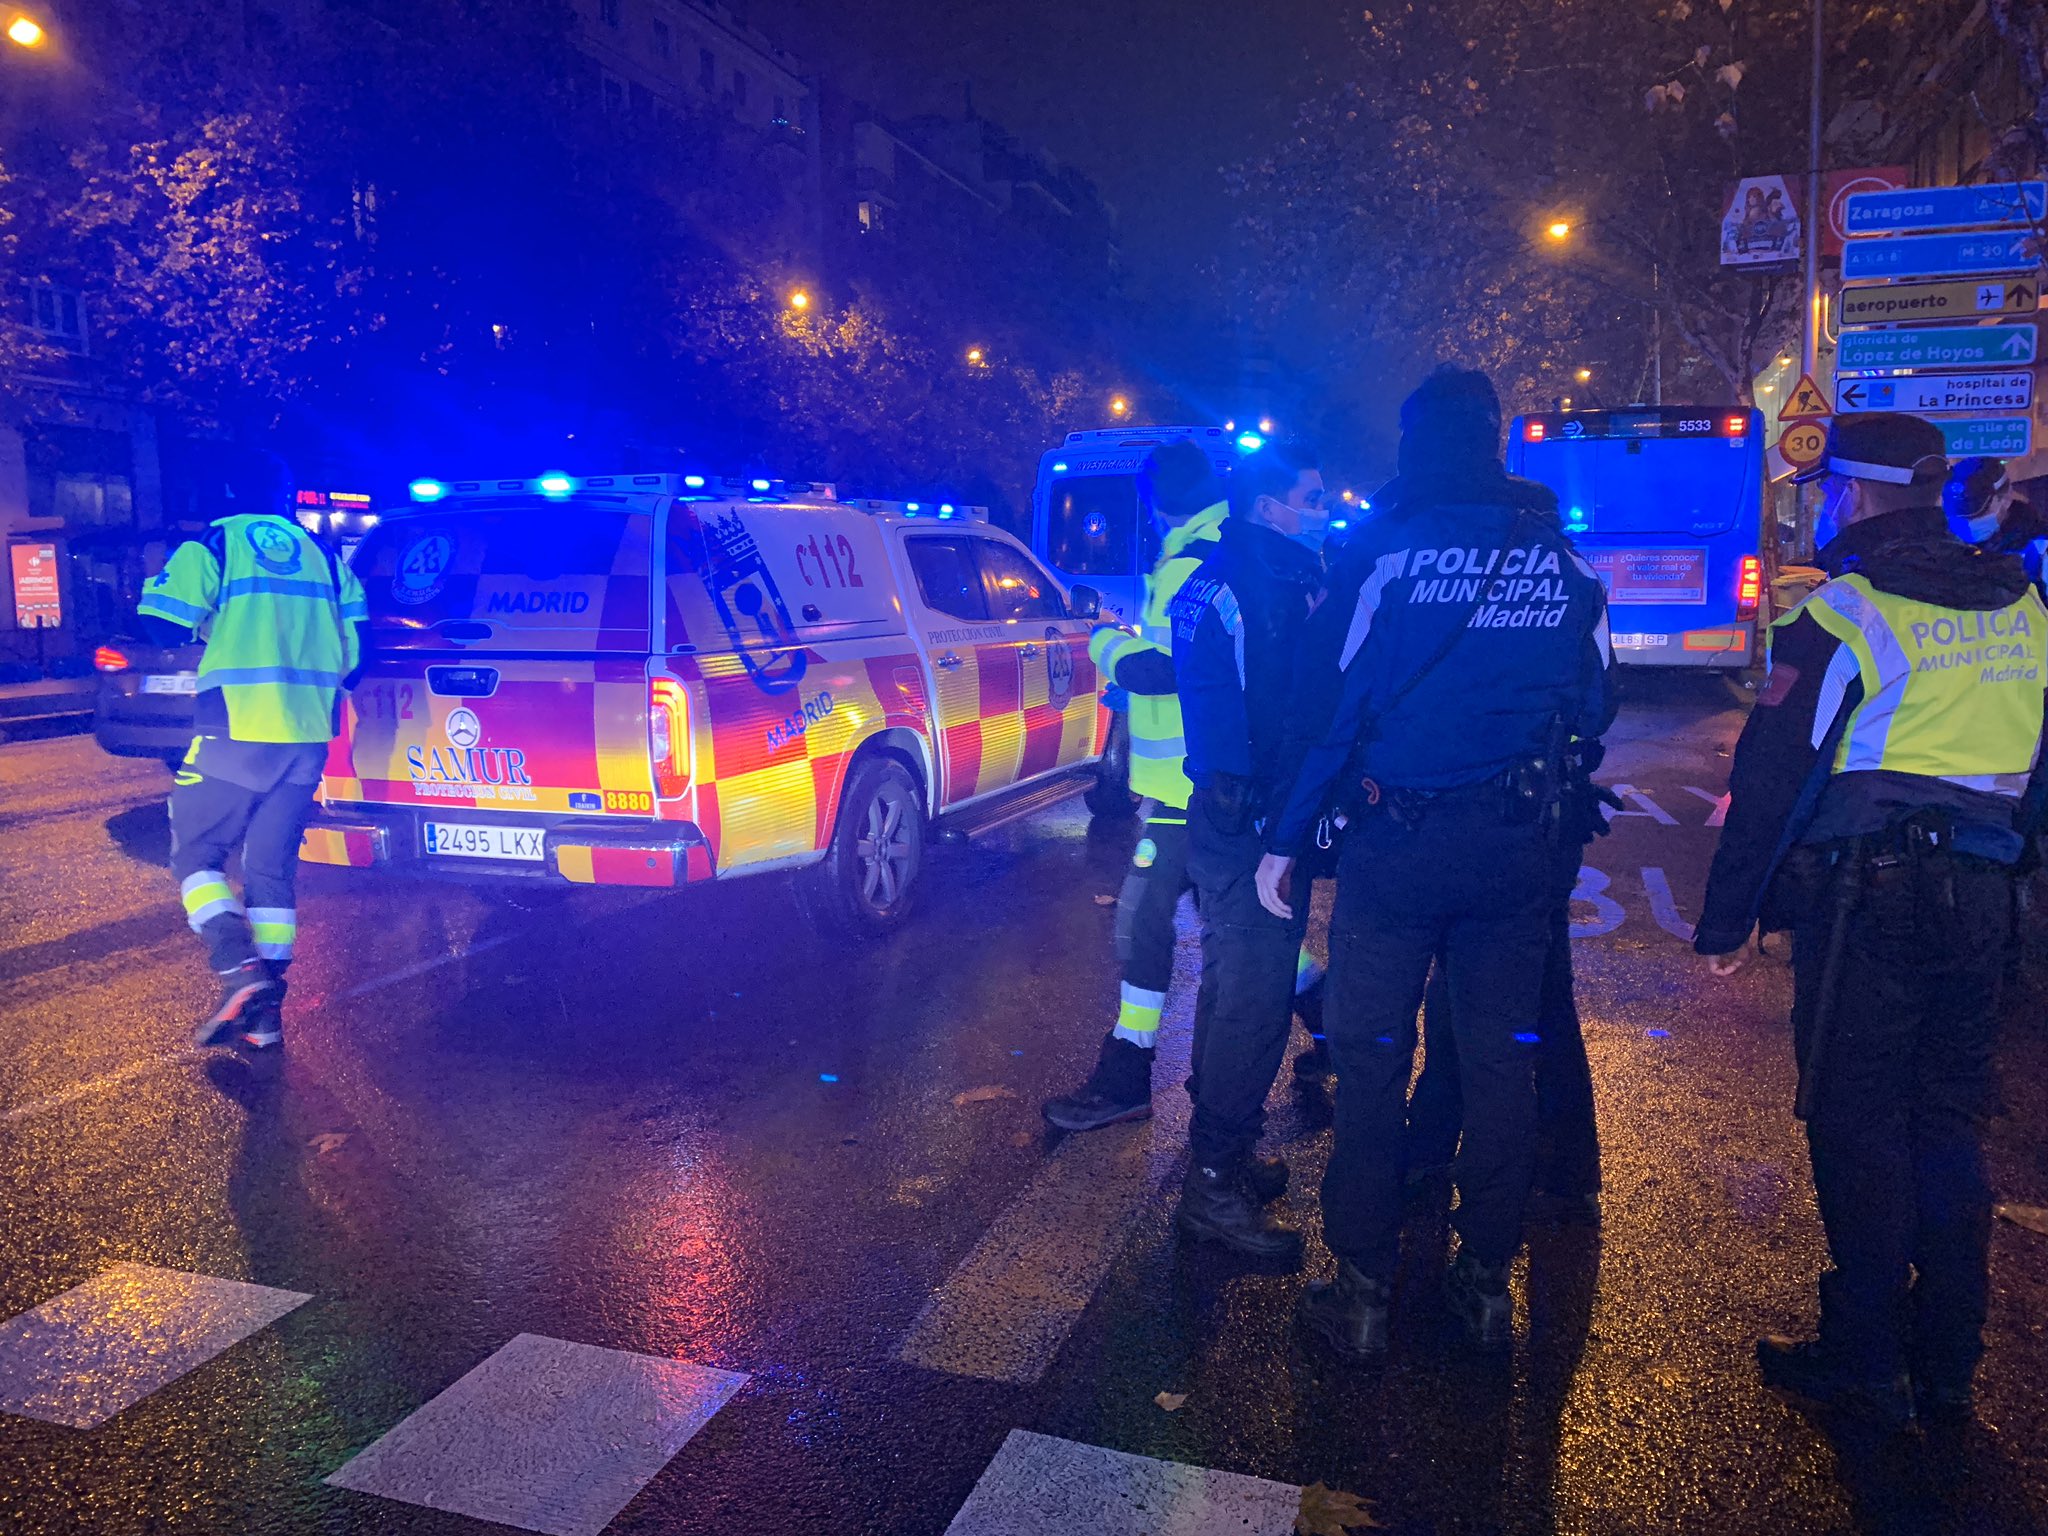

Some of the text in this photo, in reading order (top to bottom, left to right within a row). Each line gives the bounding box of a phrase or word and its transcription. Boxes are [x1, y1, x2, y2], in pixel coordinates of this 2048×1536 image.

[1851, 204, 1935, 221] Zaragoza
[1846, 294, 1948, 313] aeropuerto
[1844, 334, 1918, 347] glorieta de
[1843, 346, 1985, 364] López de Hoyos
[1947, 377, 2027, 391] hospital de
[1919, 393, 2025, 407] La Princesa
[1679, 420, 1711, 432] 5533
[2007, 421, 2025, 432] de
[1791, 437, 1820, 452] 30
[1951, 436, 2024, 450] de León
[1409, 544, 1561, 577] POLICÍA
[1620, 554, 1699, 563] ¿Quieres conocer
[1644, 572, 1686, 580] vivienda?
[487, 591, 590, 614] MADRID
[1467, 604, 1568, 628] Madrid
[928, 627, 983, 644] PROTECCION
[1647, 635, 1665, 644] SP
[1980, 664, 2038, 684] Madrid
[766, 691, 835, 754] MADRID
[407, 744, 531, 785] SAMUR
[414, 782, 536, 801] PROTECCION CIVIL
[607, 792, 650, 811] 8880
[439, 828, 541, 856] 2495 LKX
